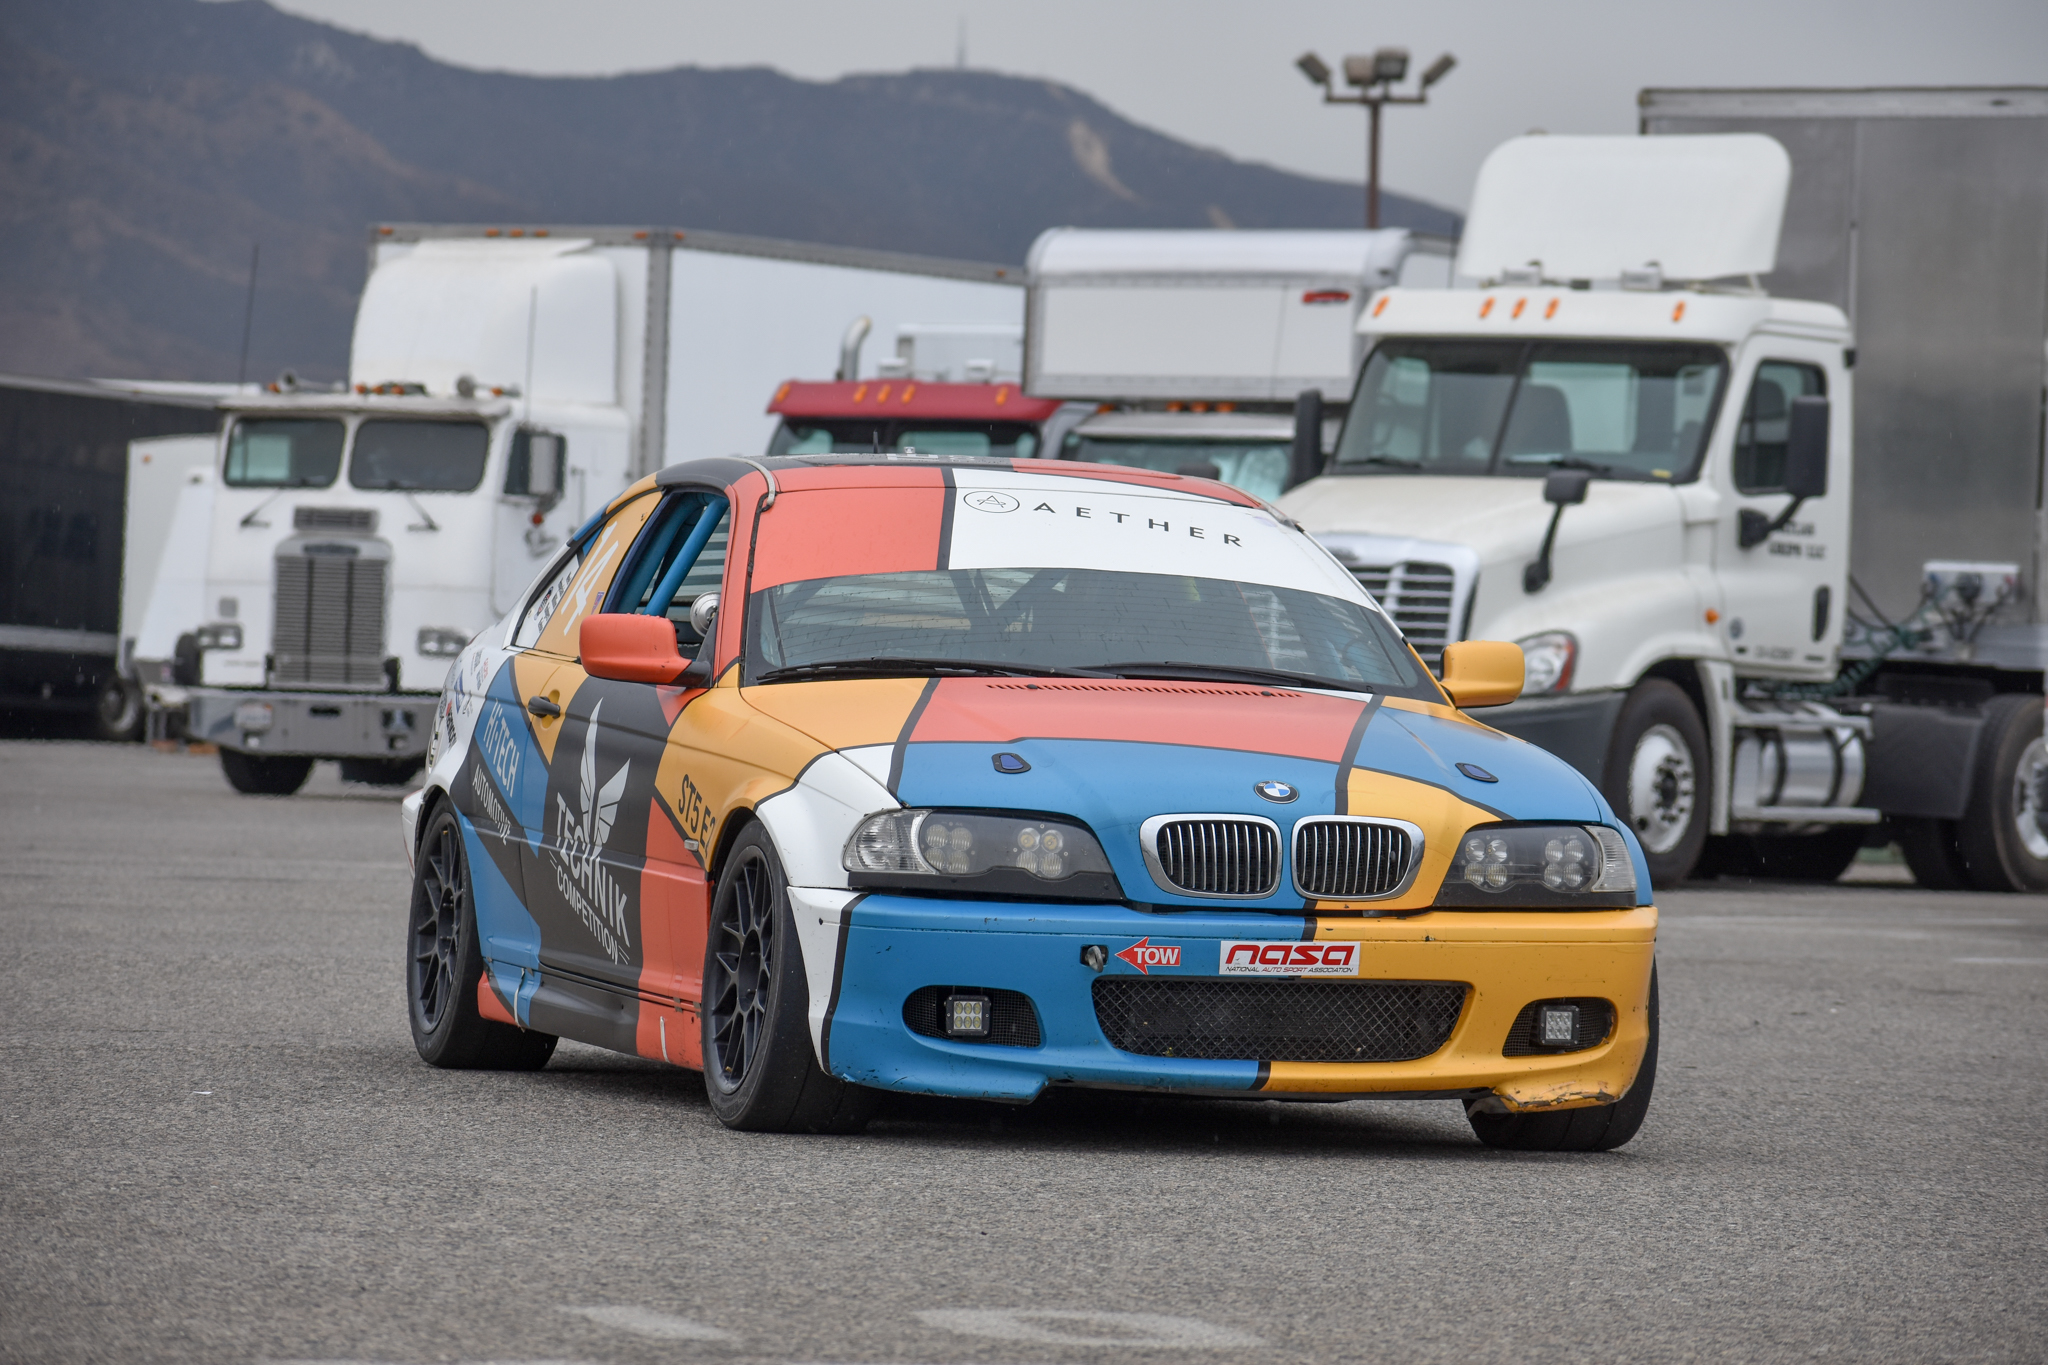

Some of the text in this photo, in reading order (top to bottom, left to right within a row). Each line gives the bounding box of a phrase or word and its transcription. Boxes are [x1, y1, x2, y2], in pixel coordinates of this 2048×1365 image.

[1033, 502, 1242, 547] AETHER
[561, 521, 618, 636] 14
[472, 764, 512, 846] AUTOMOTIVE
[678, 773, 702, 834] ST5
[556, 792, 630, 948] TECHNIK
[557, 865, 618, 965] COMPETITION
[1133, 947, 1179, 964] TOW
